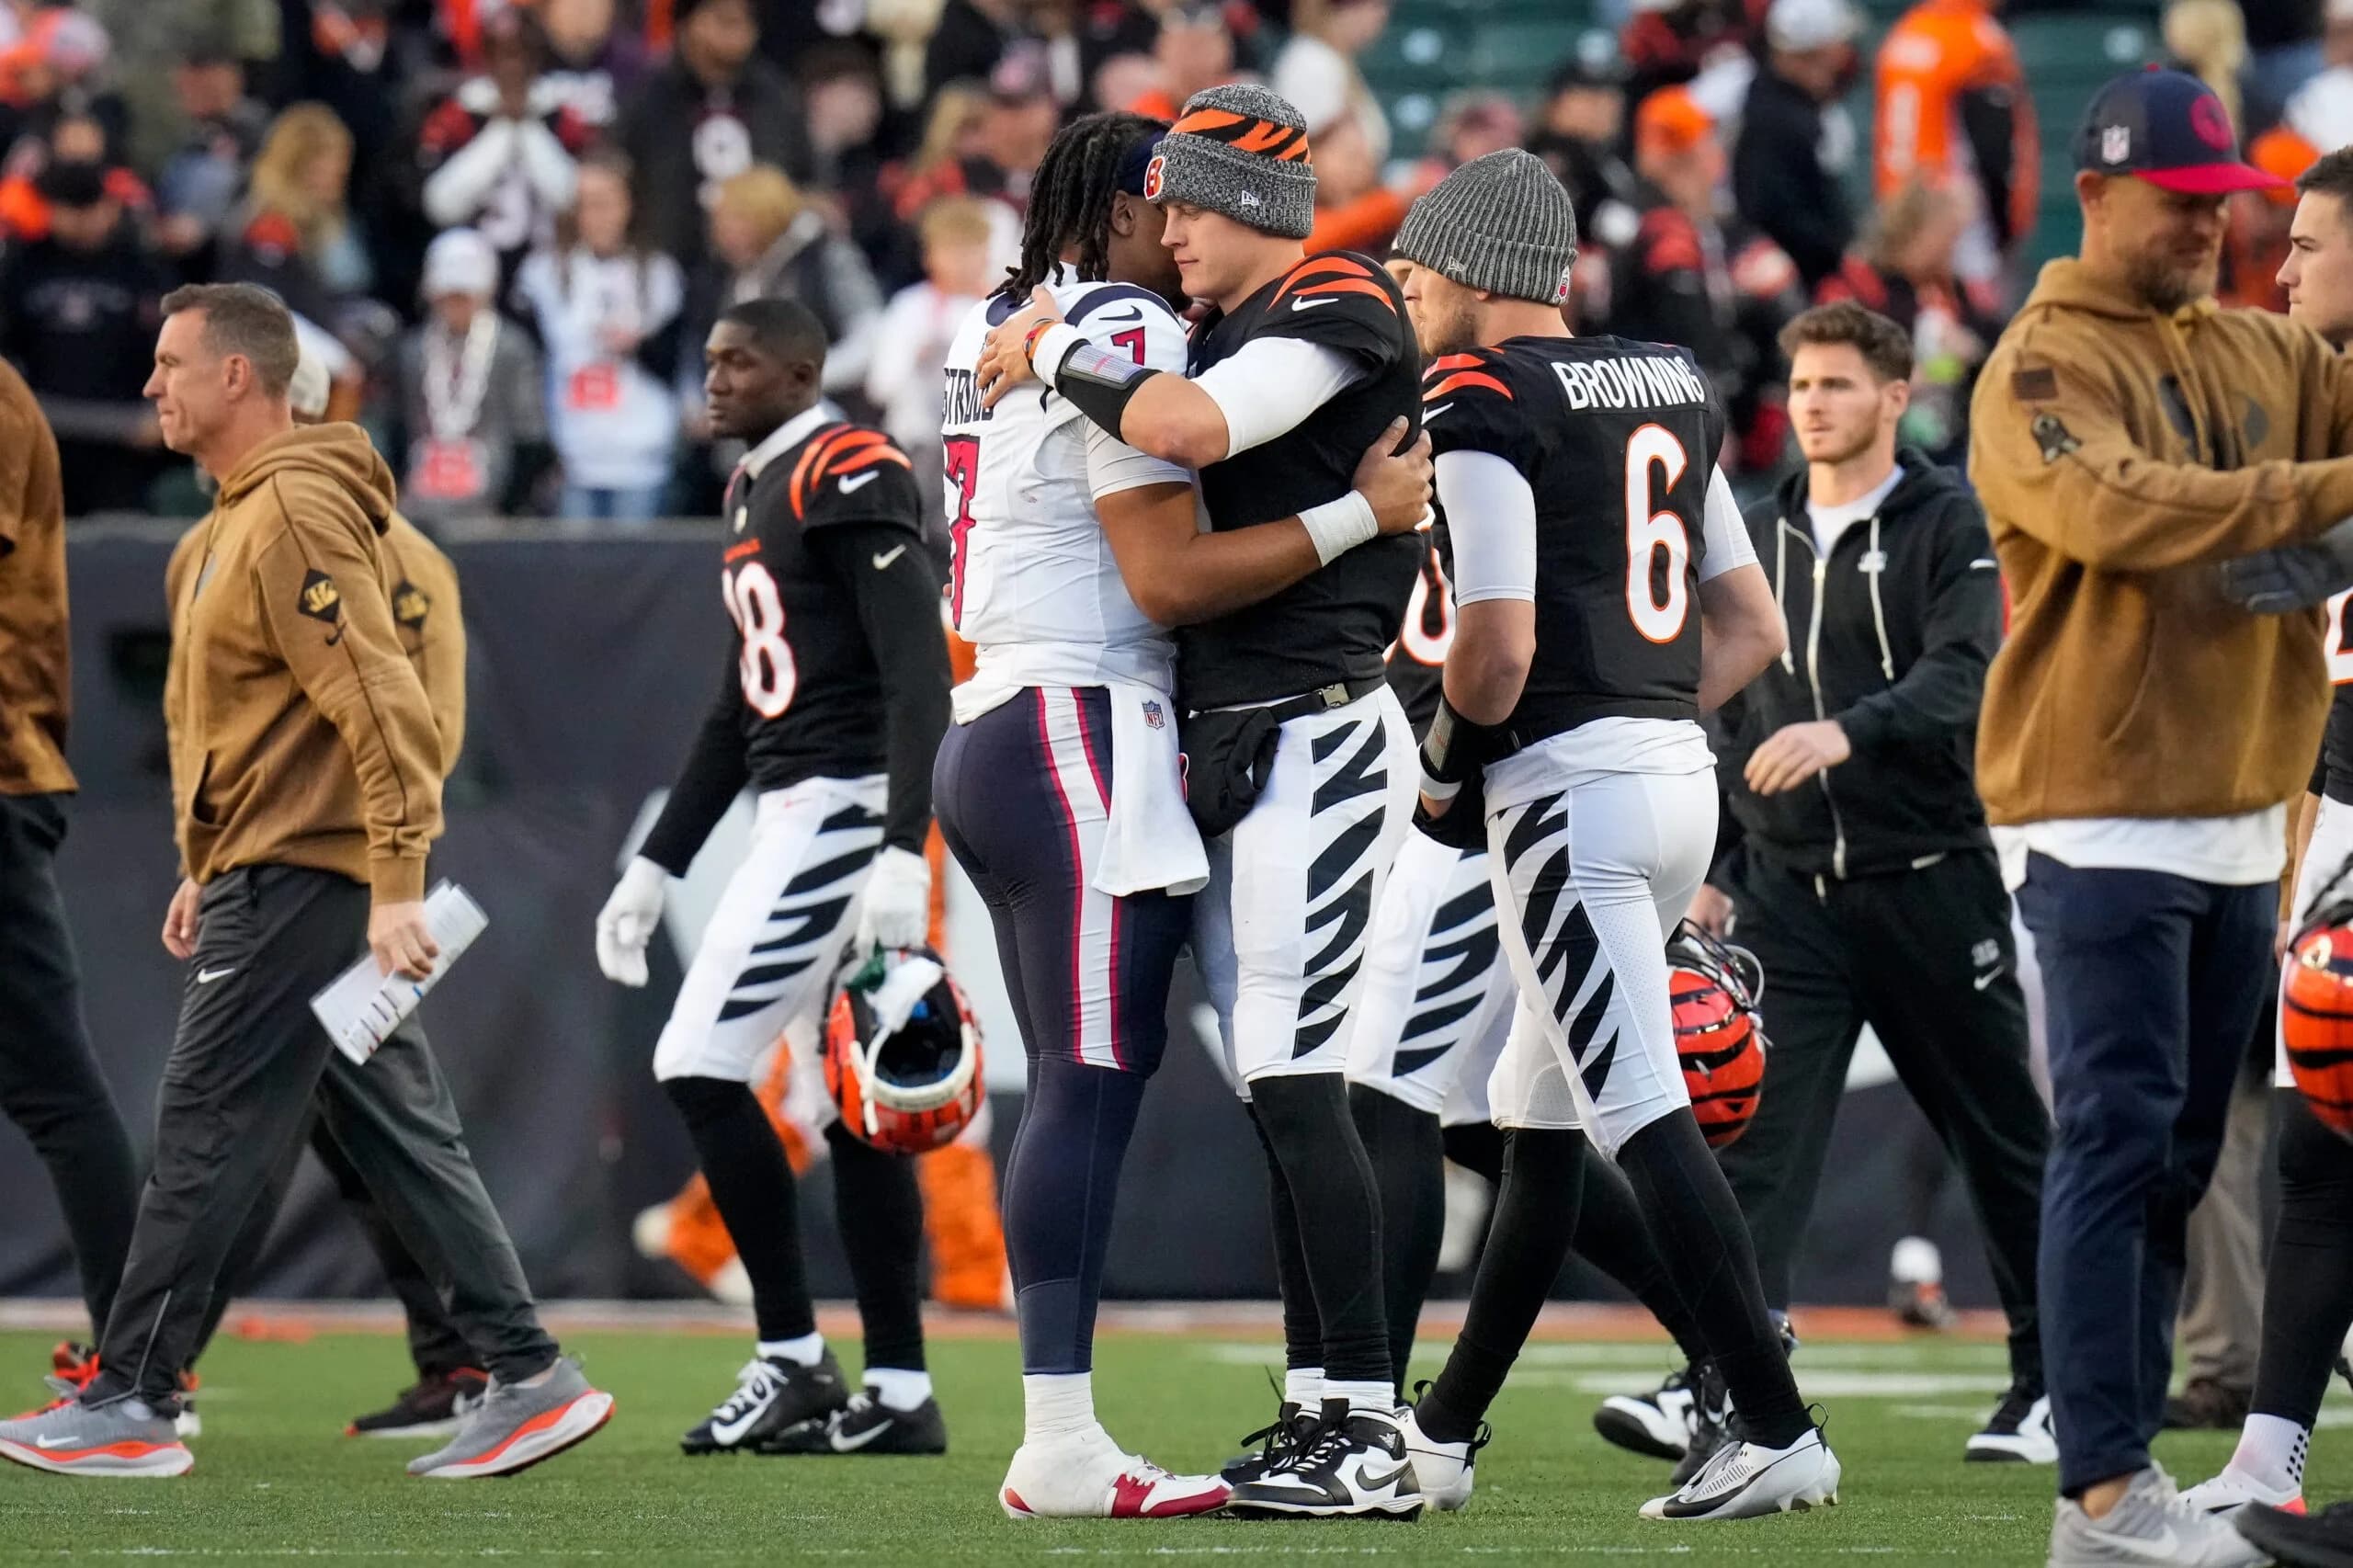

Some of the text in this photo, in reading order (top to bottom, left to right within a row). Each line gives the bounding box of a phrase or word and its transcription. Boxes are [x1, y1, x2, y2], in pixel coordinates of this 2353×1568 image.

[1110, 326, 1146, 366] 7
[1551, 356, 1705, 411] BROWNING
[943, 434, 981, 631] 7
[1625, 423, 1688, 643] 6
